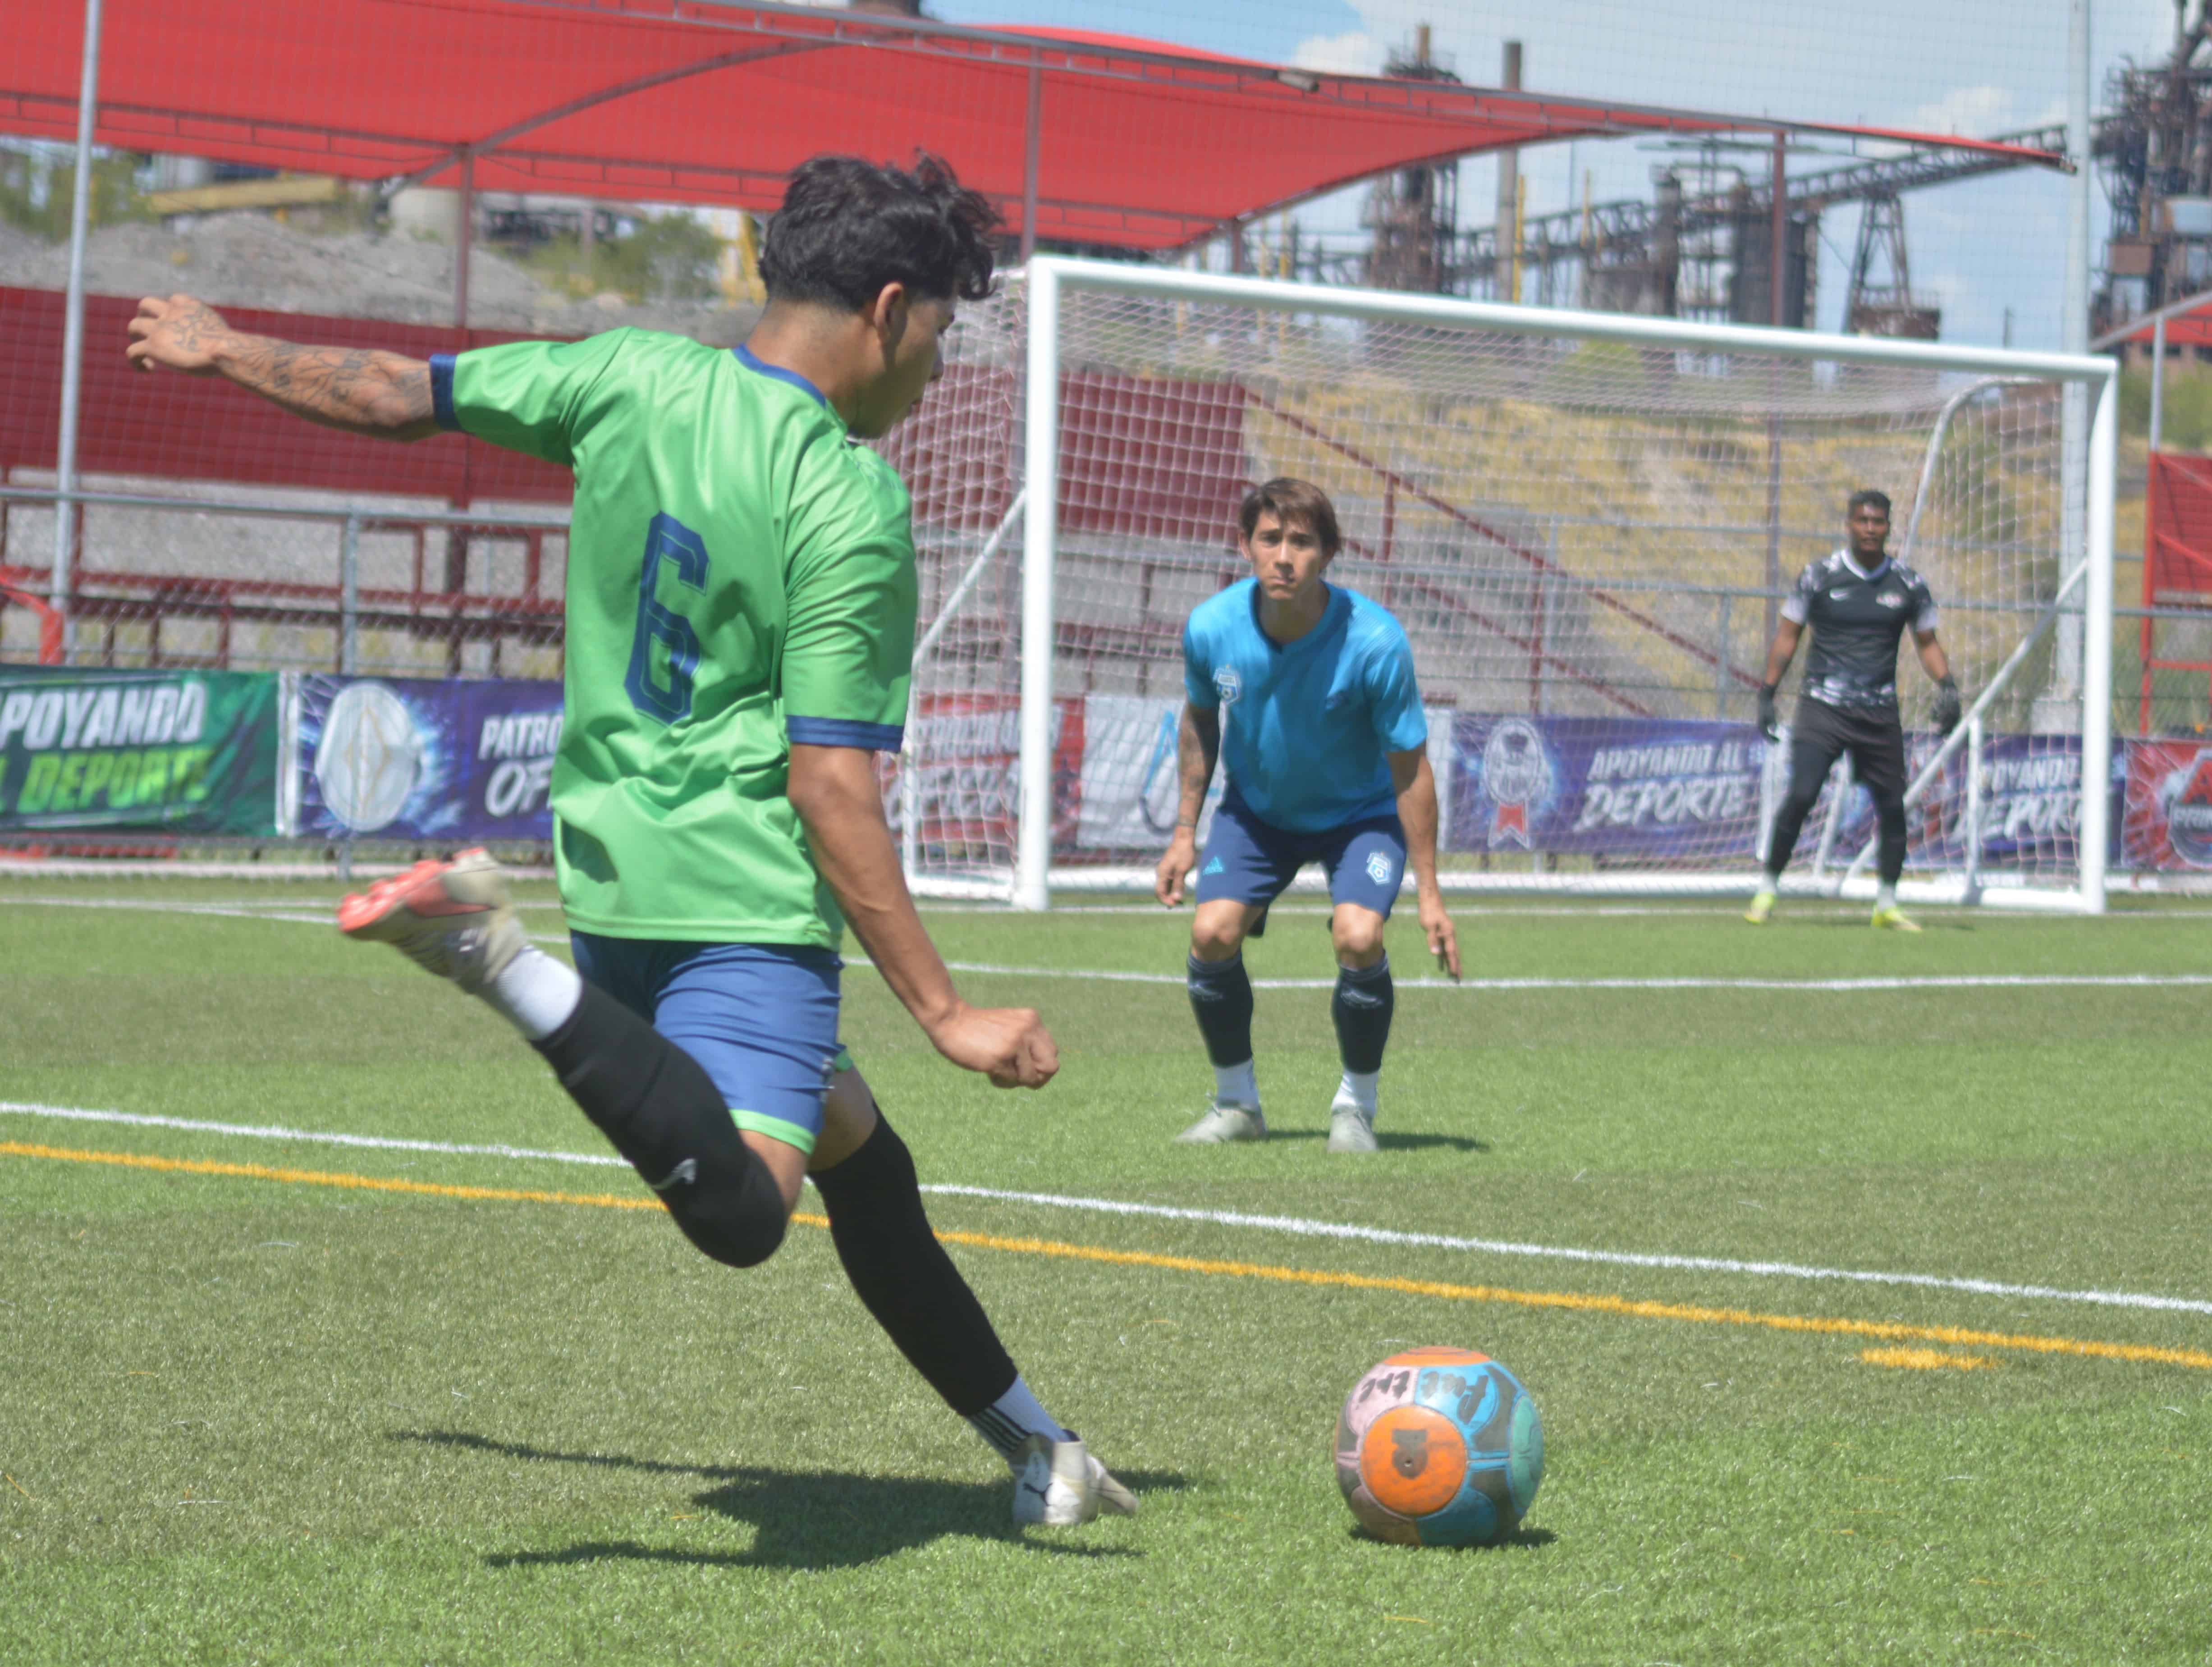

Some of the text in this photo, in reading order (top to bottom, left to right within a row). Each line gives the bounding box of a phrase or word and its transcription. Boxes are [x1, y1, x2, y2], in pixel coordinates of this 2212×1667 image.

[624, 510, 710, 728] 6
[485, 757, 555, 817] OF
[1586, 744, 1713, 781] APOYANDO
[1573, 775, 1750, 833] DEPORTE
